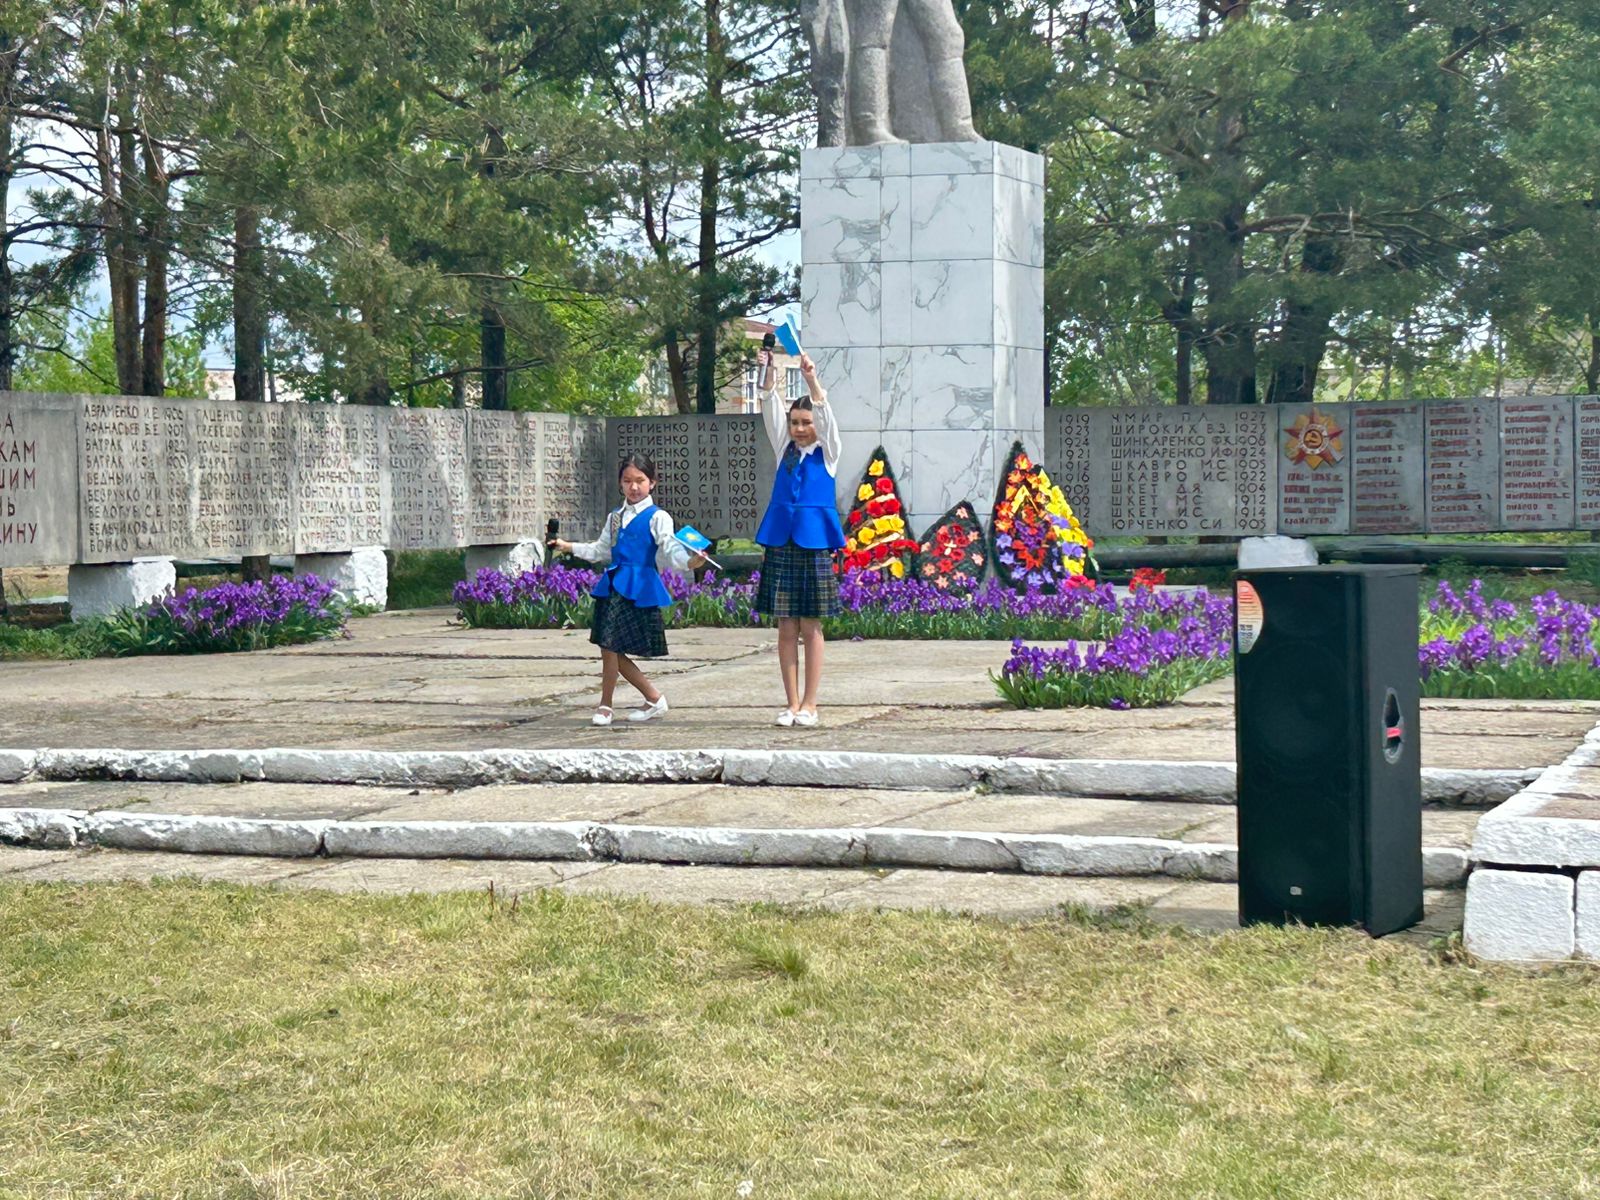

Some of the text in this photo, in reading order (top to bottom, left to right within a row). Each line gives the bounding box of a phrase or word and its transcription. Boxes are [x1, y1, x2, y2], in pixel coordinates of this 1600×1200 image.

[1059, 414, 1090, 424] 1919
[1112, 412, 1163, 423] ЧМИР
[1235, 411, 1266, 422] 1927
[85, 422, 140, 436] АФАНАСЬЕВ
[617, 422, 688, 434] СЕРГИЕНКО
[727, 421, 756, 432] 1903
[1059, 425, 1090, 437] 1923
[1112, 423, 1198, 436] ШИРОКИХ
[86, 439, 123, 452] БАТРАК
[617, 435, 688, 447] СЕРГИЕНКО
[727, 434, 756, 444] 1914
[1059, 437, 1090, 448] 1924
[1112, 436, 1205, 447] ШИНКАРЕНКО
[1059, 448, 1090, 459] 1921
[1112, 447, 1205, 459] ШИНКАРЕНКО
[1059, 460, 1090, 471] 1912
[1112, 459, 1187, 471] ШКАВРО
[728, 471, 757, 481] 1916
[1059, 473, 1090, 483] 1916
[1112, 471, 1188, 482] ШКАВРО
[1235, 470, 1266, 482] 1922
[1112, 483, 1158, 494] ШКЕТ
[1112, 495, 1158, 506] ШКЕТ
[1235, 494, 1266, 505] 1912
[1112, 507, 1158, 518] ШКЕТ
[1235, 506, 1266, 517] 1914
[1112, 519, 1188, 530] ЮРЧЕНКО
[0, 523, 37, 543] ИНУ
